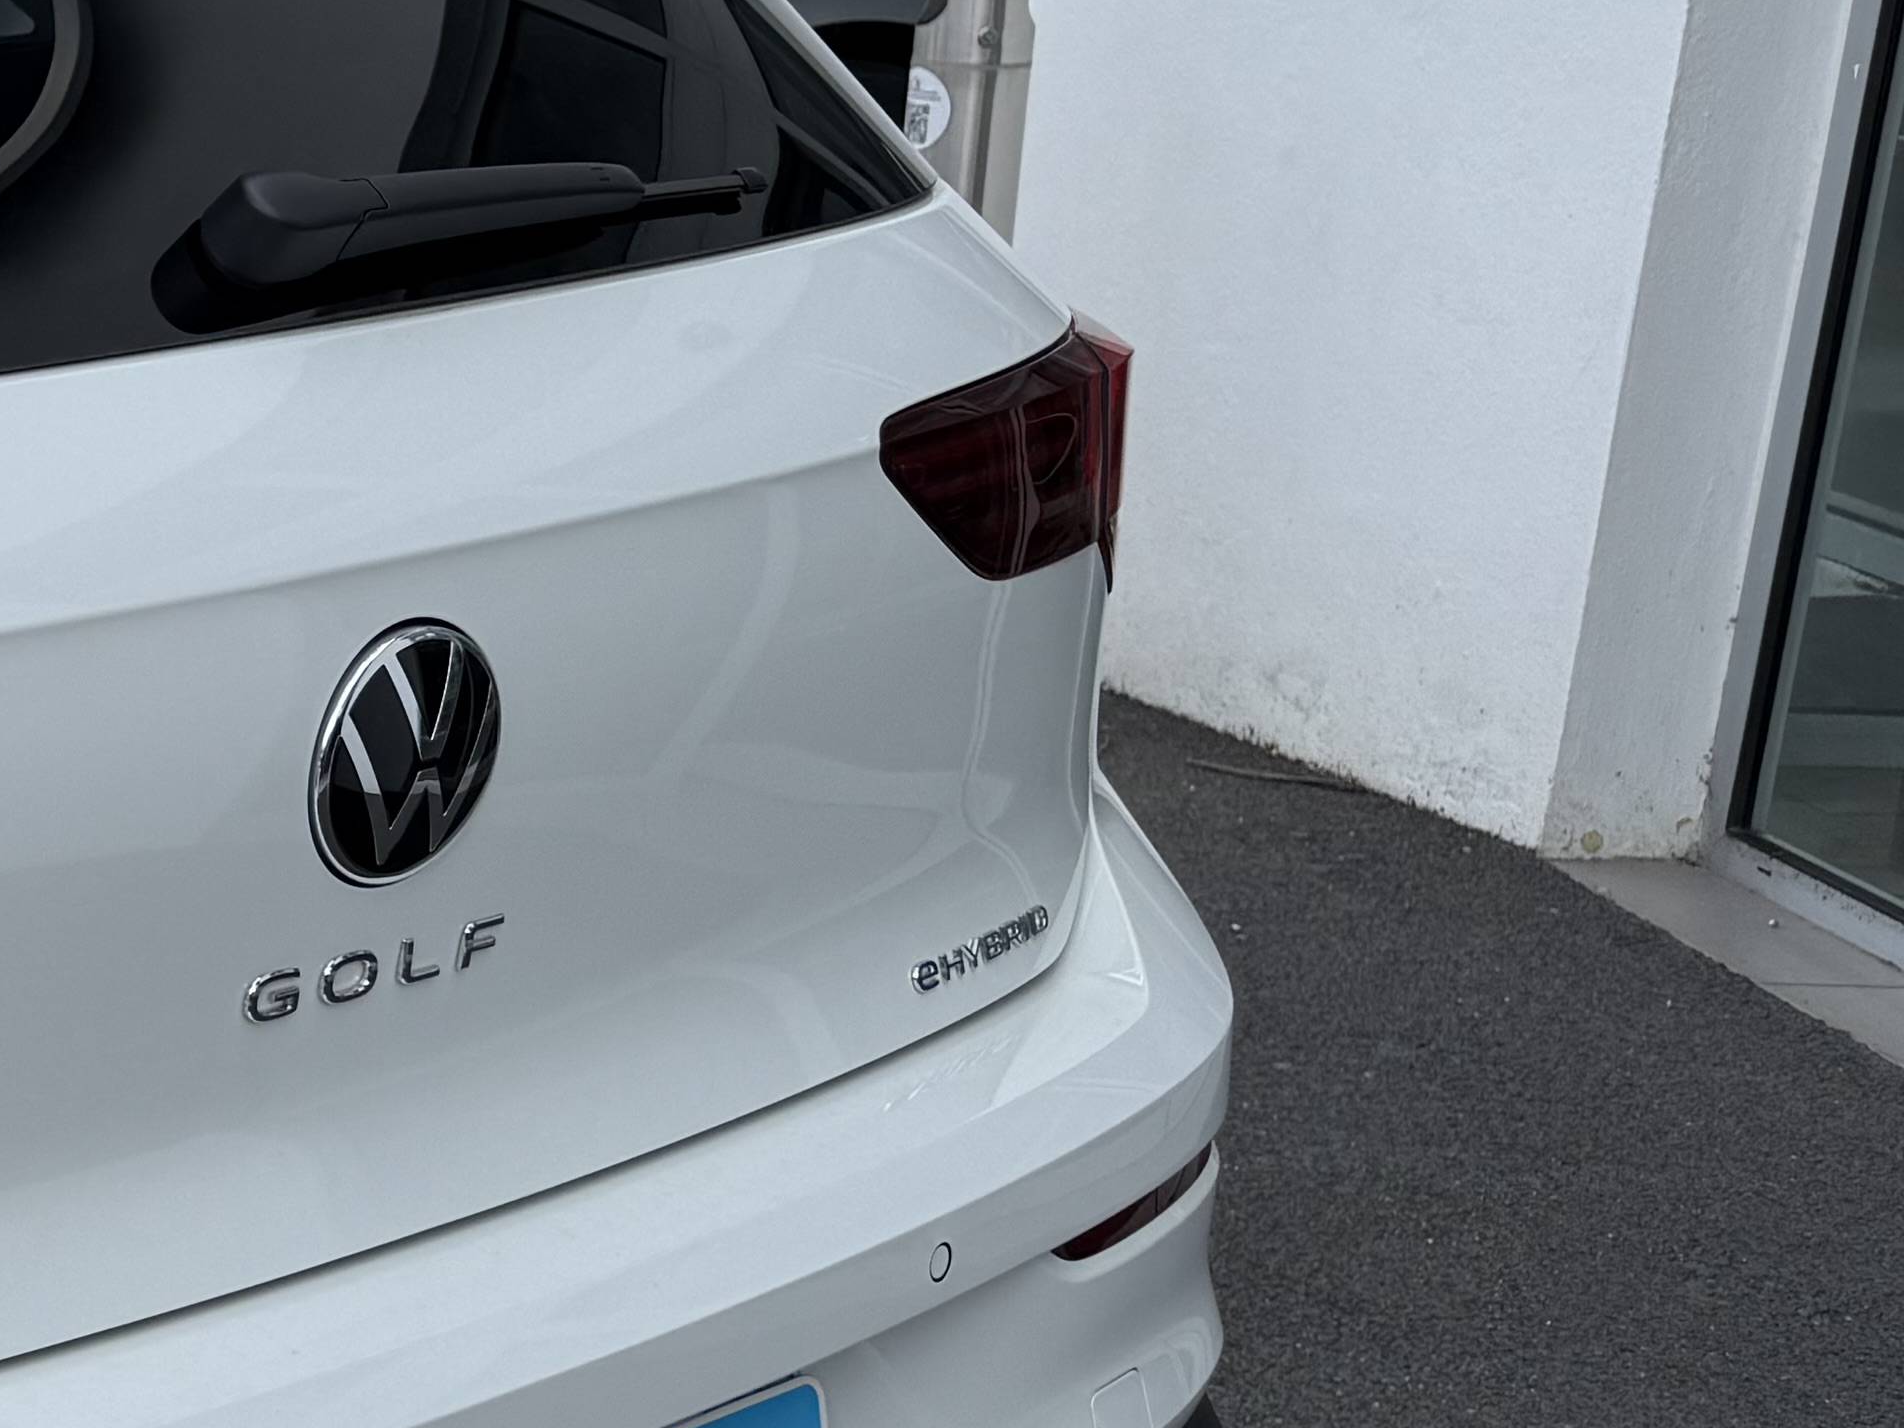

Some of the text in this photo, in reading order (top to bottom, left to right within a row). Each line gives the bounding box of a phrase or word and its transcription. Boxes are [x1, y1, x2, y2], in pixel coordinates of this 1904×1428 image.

[310, 618, 503, 888] VW
[243, 913, 505, 1023] GOLF
[911, 905, 1049, 995] eHYBRID
